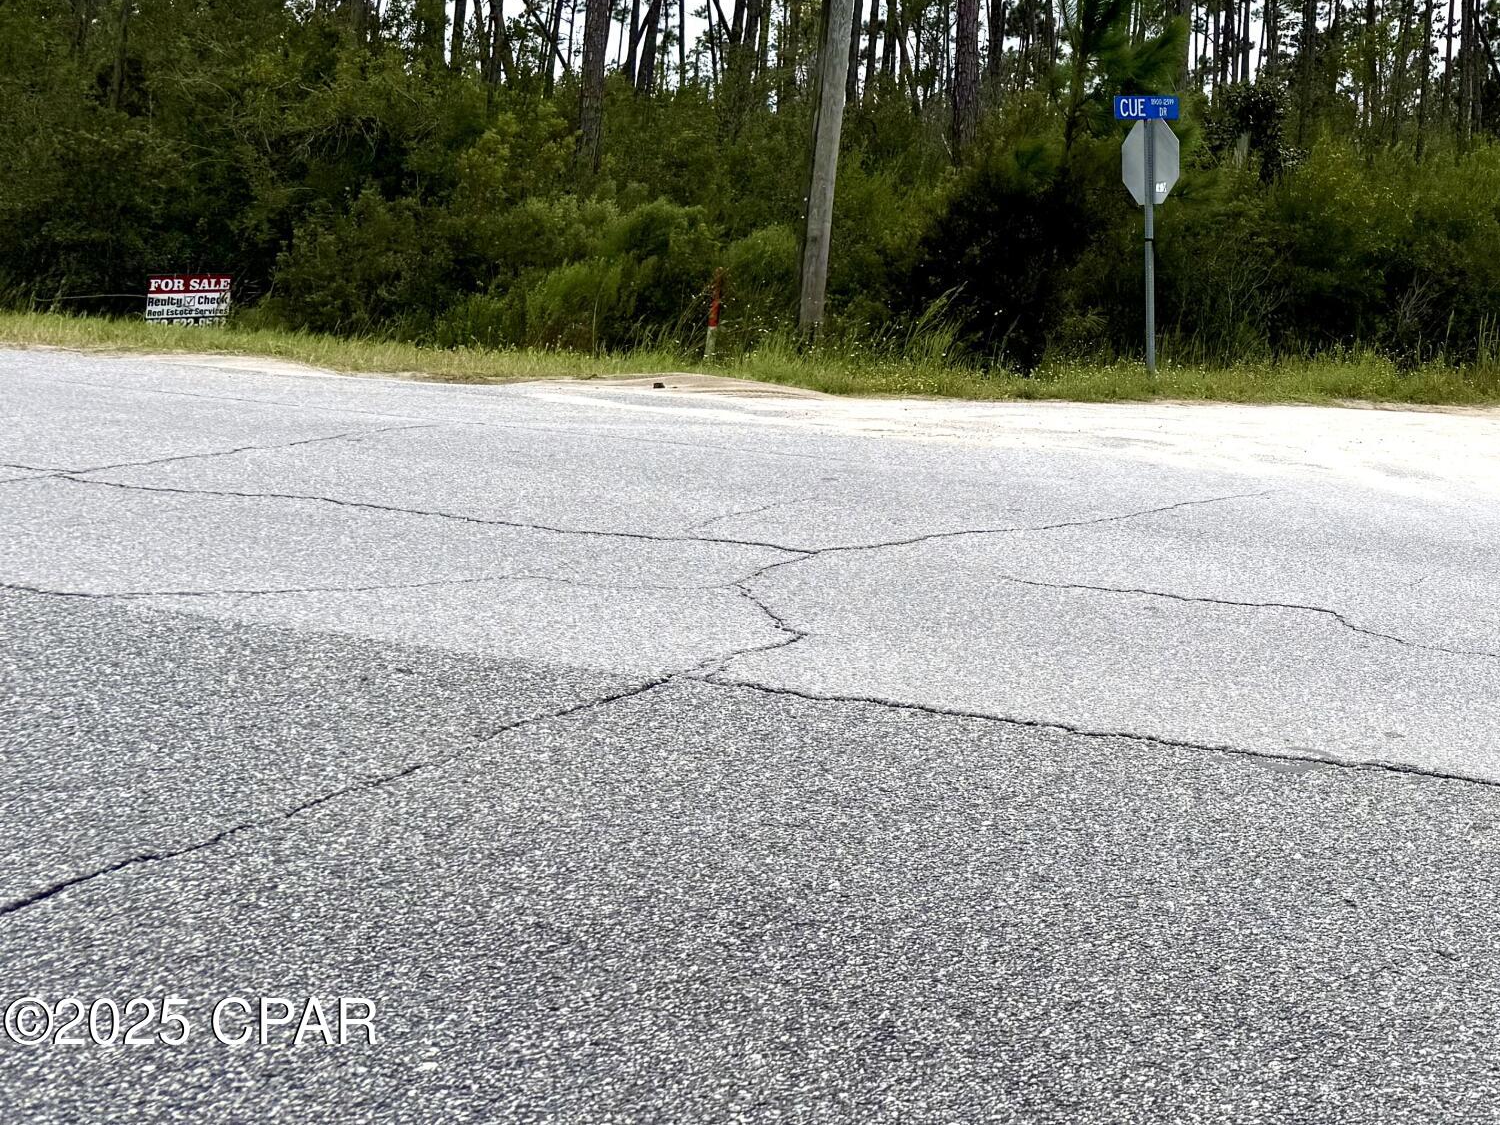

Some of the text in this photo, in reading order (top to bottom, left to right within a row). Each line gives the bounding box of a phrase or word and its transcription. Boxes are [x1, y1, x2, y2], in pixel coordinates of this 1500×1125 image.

[1120, 98, 1168, 116] CUE DR
[149, 278, 231, 291] FOR SALE
[147, 295, 228, 308] Realty Check
[147, 307, 229, 317] Real Estate Services
